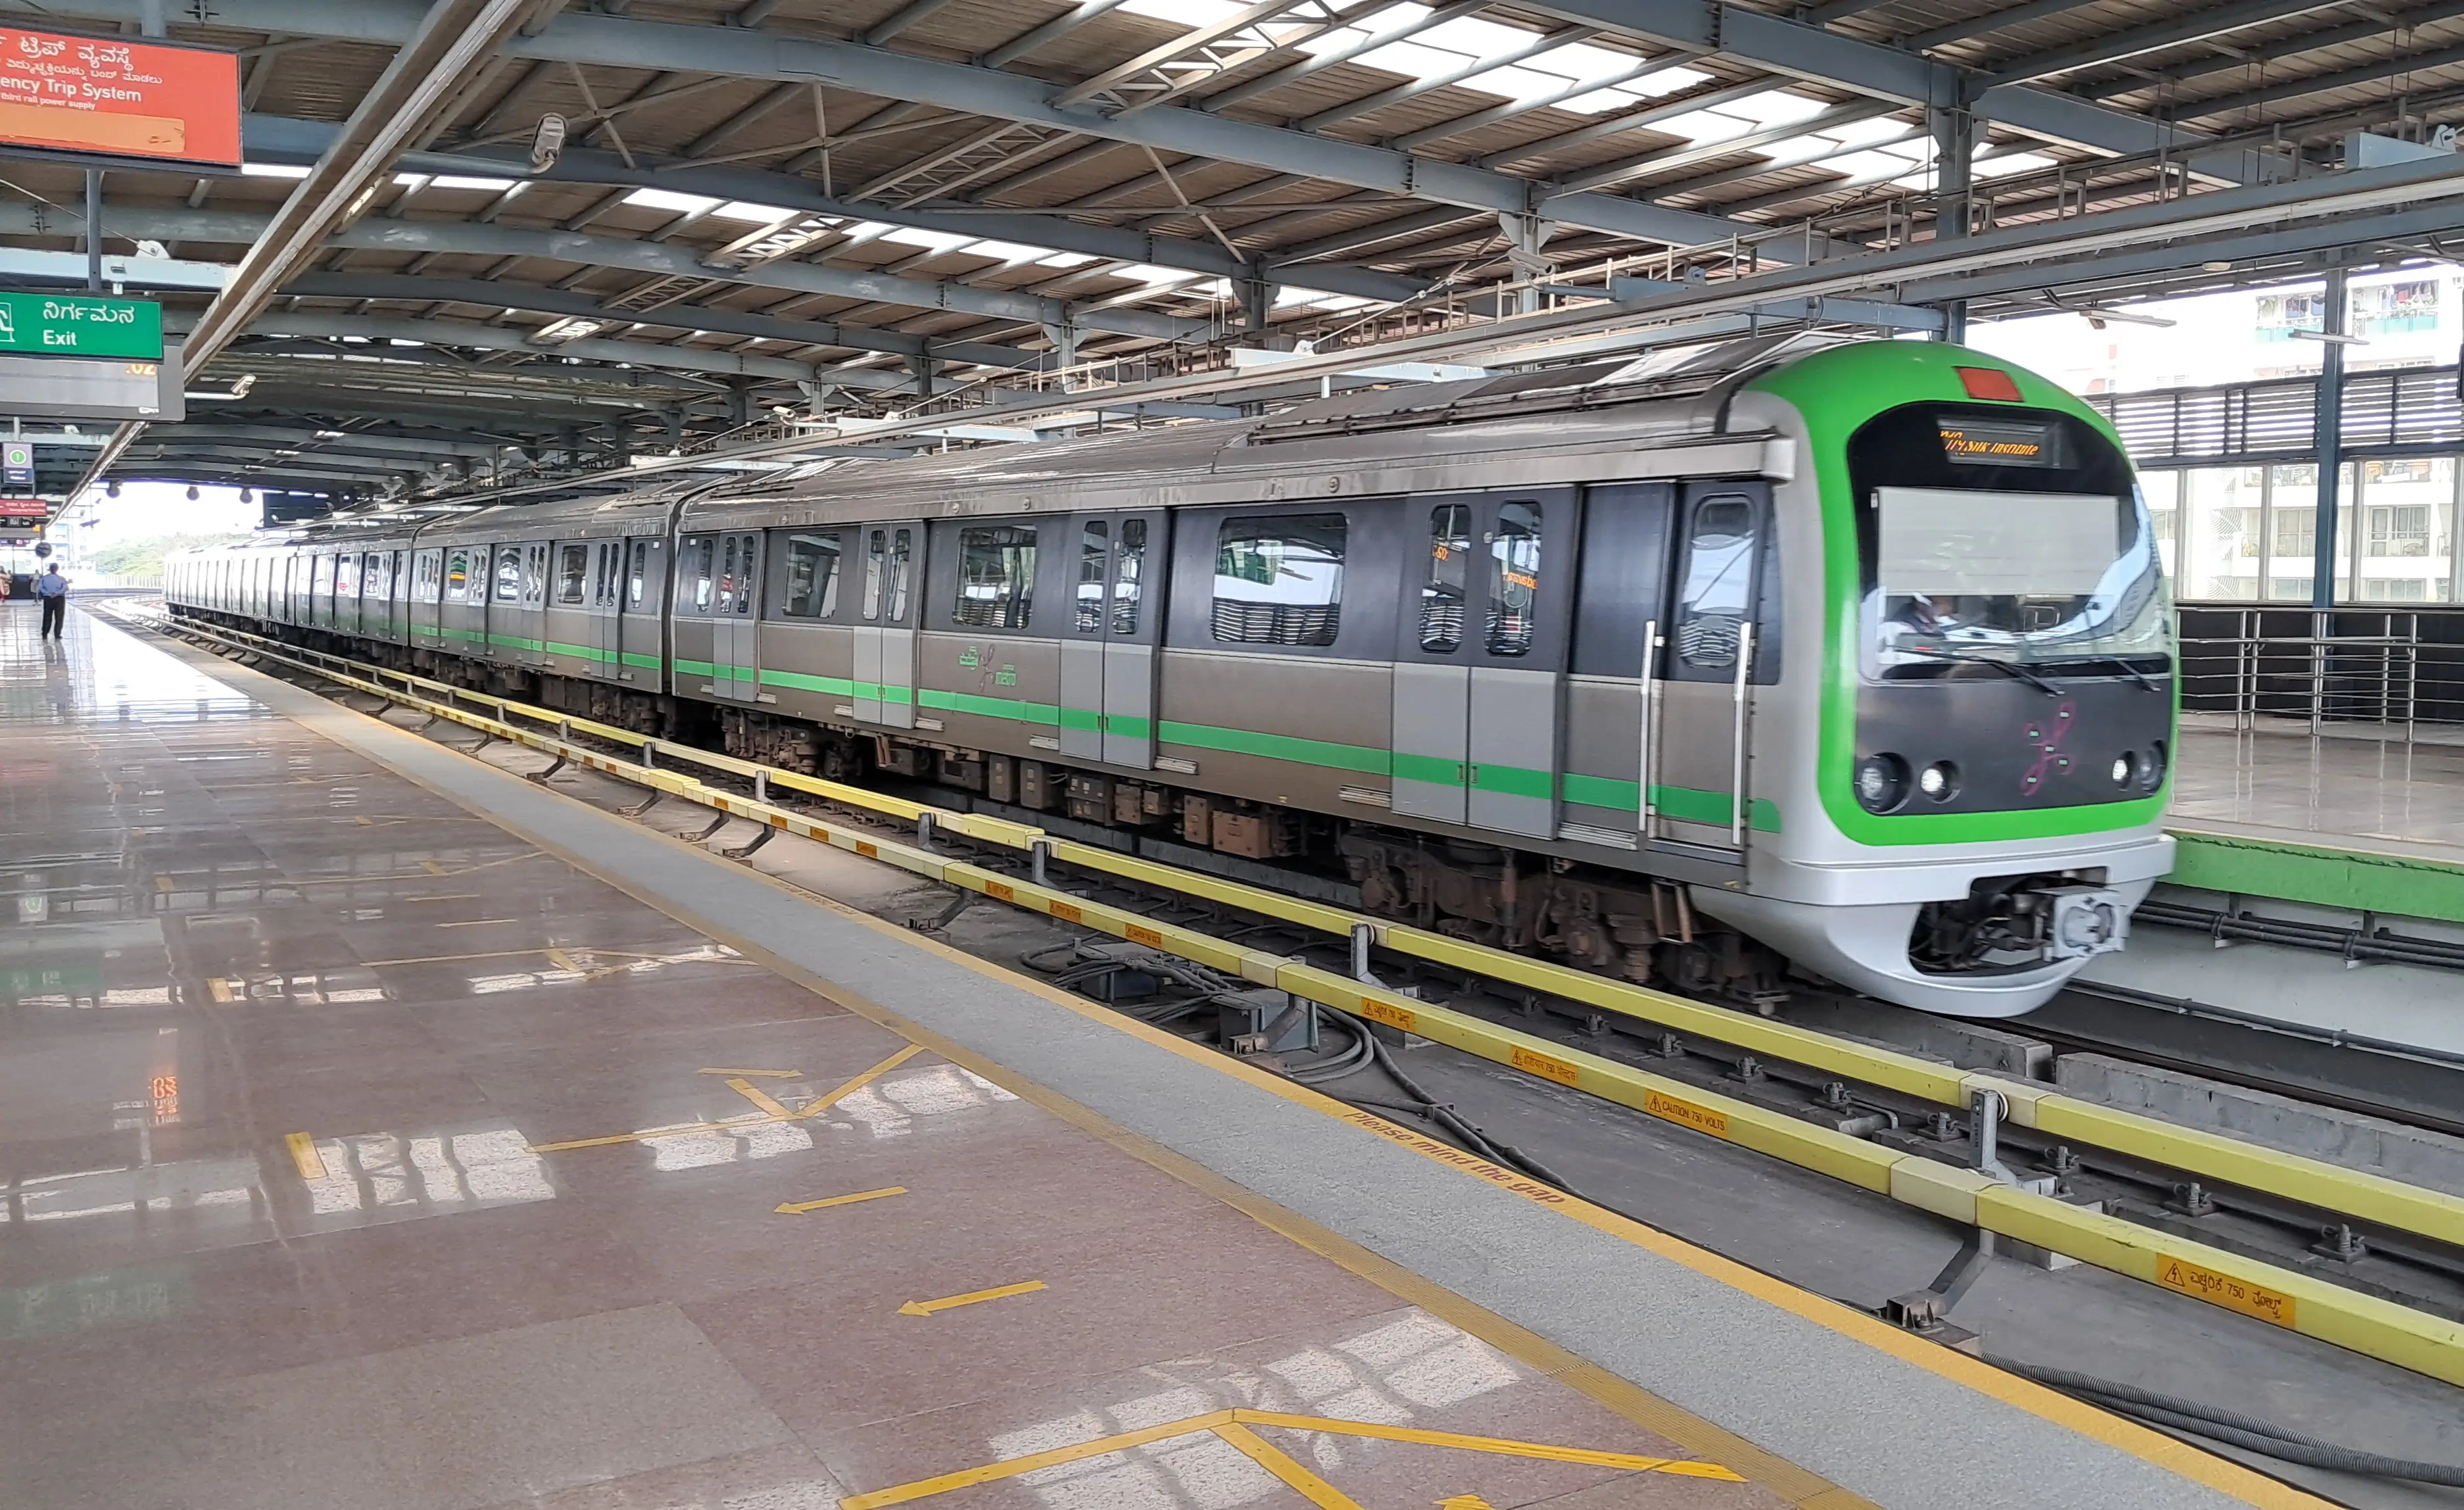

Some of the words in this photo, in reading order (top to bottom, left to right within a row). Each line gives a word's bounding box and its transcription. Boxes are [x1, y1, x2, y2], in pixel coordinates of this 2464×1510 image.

[0, 76, 41, 94] ency
[44, 78, 77, 98] Trip
[82, 83, 141, 102] System
[39, 97, 66, 106] power
[68, 101, 96, 110] supply
[43, 301, 135, 324] ನಿರ್ಗಮನ
[43, 329, 78, 346] Exit
[1662, 1101, 1689, 1119] CAUTION
[1692, 1111, 1703, 1123] 750
[1704, 1115, 1725, 1131] VOLTS
[1343, 1112, 1414, 1140] Please
[1411, 1142, 1479, 1165] mind
[1470, 1165, 1514, 1181] the
[1507, 1183, 1565, 1203] gap
[2227, 1283, 2244, 1300] 750
